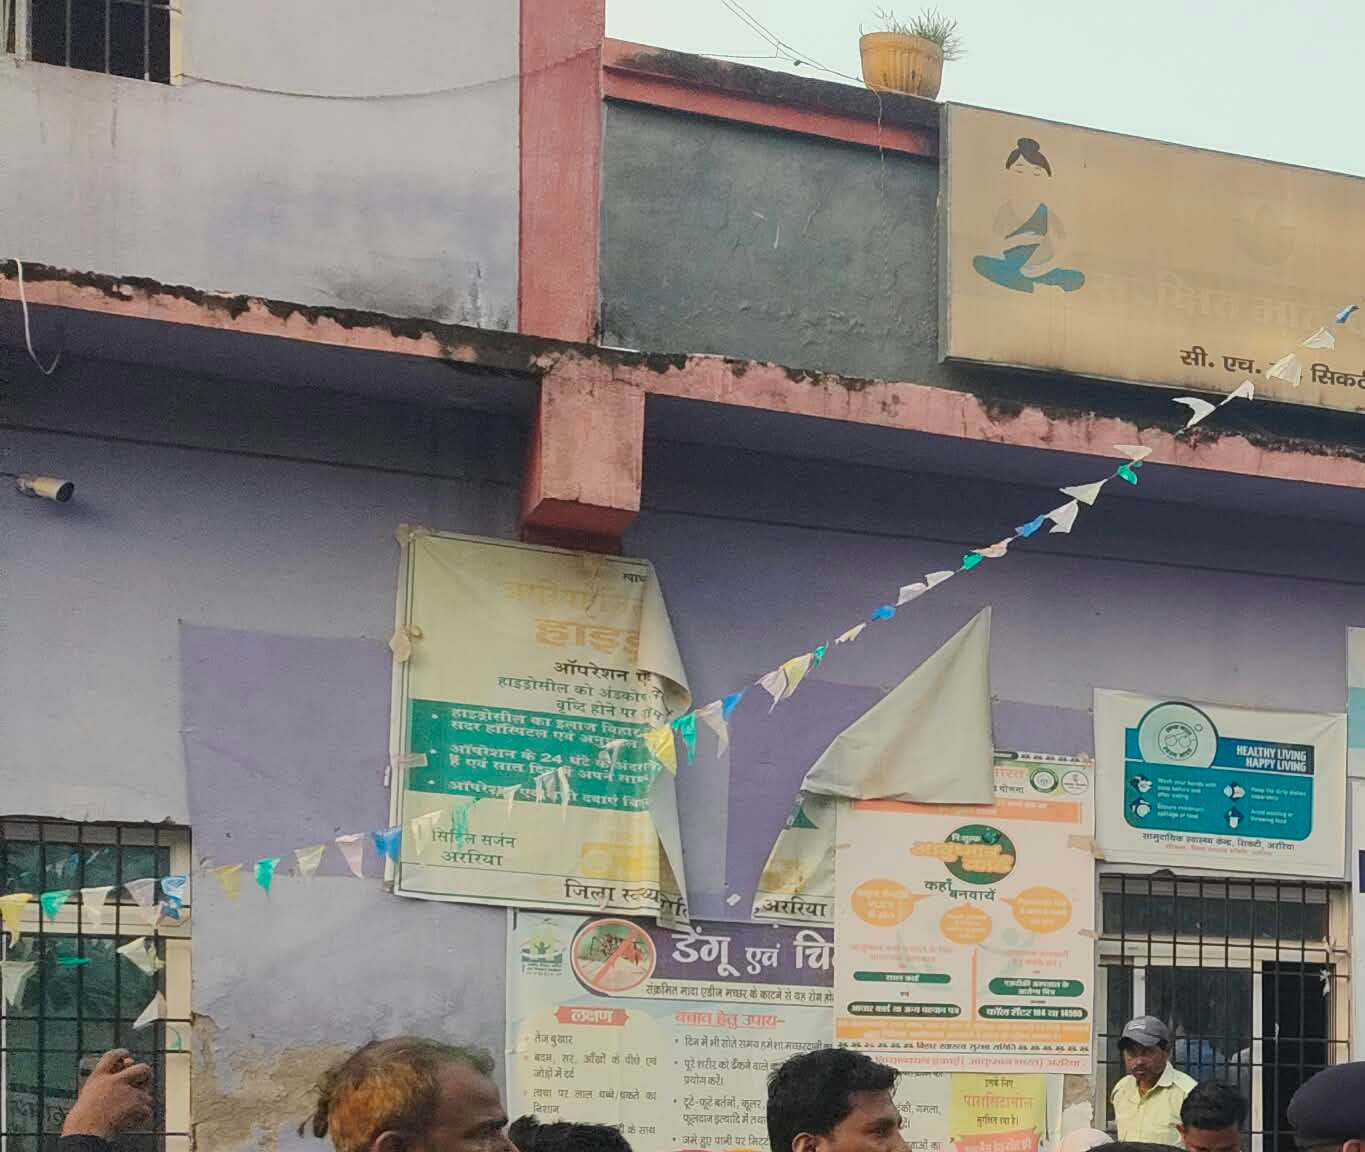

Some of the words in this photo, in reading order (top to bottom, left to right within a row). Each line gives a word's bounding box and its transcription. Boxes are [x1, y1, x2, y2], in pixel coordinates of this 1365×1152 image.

[1180, 346, 1215, 368] सी.
[1222, 355, 1261, 374] एच.
[553, 659, 629, 682] ऑपरेशन
[497, 676, 569, 696] हाइड्रोसील
[575, 684, 593, 697] को
[621, 707, 636, 718] पर
[541, 753, 562, 764] 24
[1236, 744, 1276, 759] HEALTHY
[1277, 749, 1306, 761] LIVING
[1246, 757, 1275, 769] HAPPY
[1277, 760, 1306, 772] LIVING
[481, 832, 517, 848] सर्जन
[441, 849, 503, 866] अररिया
[924, 878, 951, 892] कहाँ
[564, 879, 615, 902] जिला
[763, 896, 827, 917] अररिया
[950, 887, 997, 901] बनवायें
[671, 926, 741, 977] डेंगू
[745, 944, 781, 974] एवं
